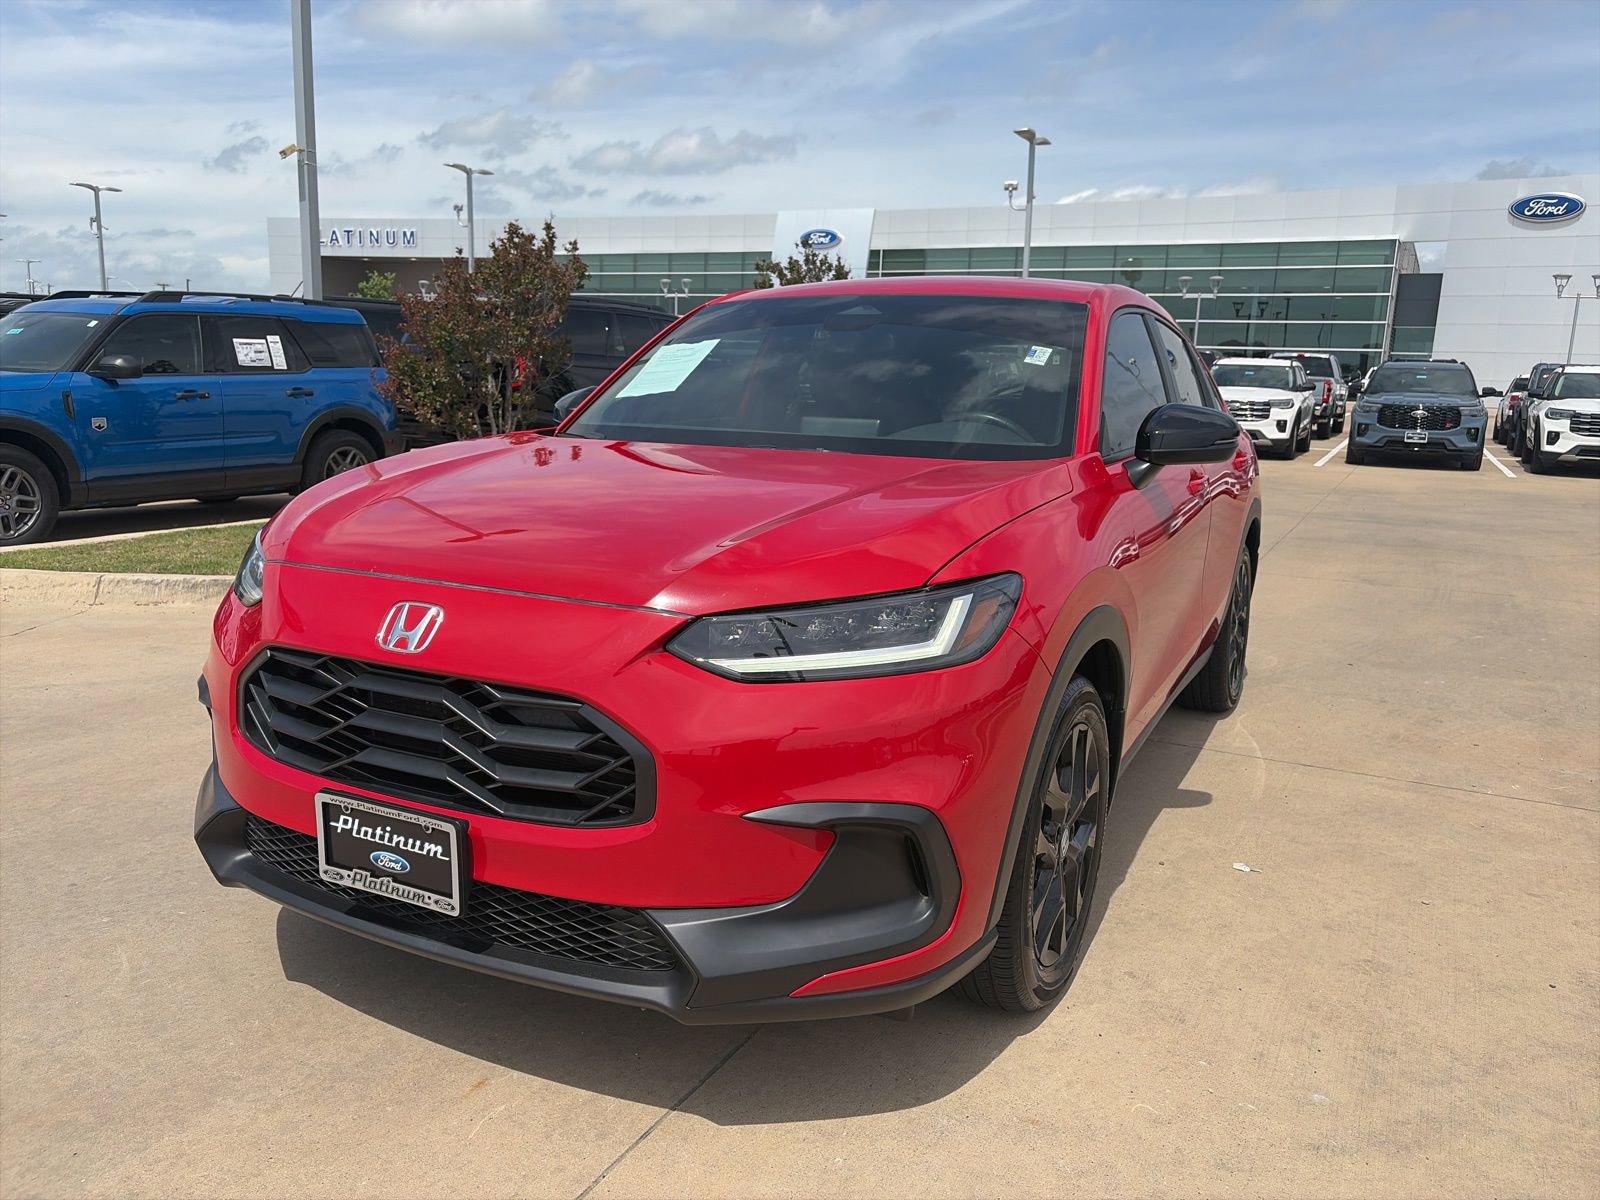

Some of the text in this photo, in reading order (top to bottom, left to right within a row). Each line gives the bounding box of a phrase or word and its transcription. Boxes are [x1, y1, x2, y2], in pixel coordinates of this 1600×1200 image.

[1524, 199, 1569, 216] Ford
[808, 232, 832, 244] Ford
[329, 815, 450, 861] Platinum
[377, 853, 403, 872] Ford
[352, 870, 431, 906] Platinum
